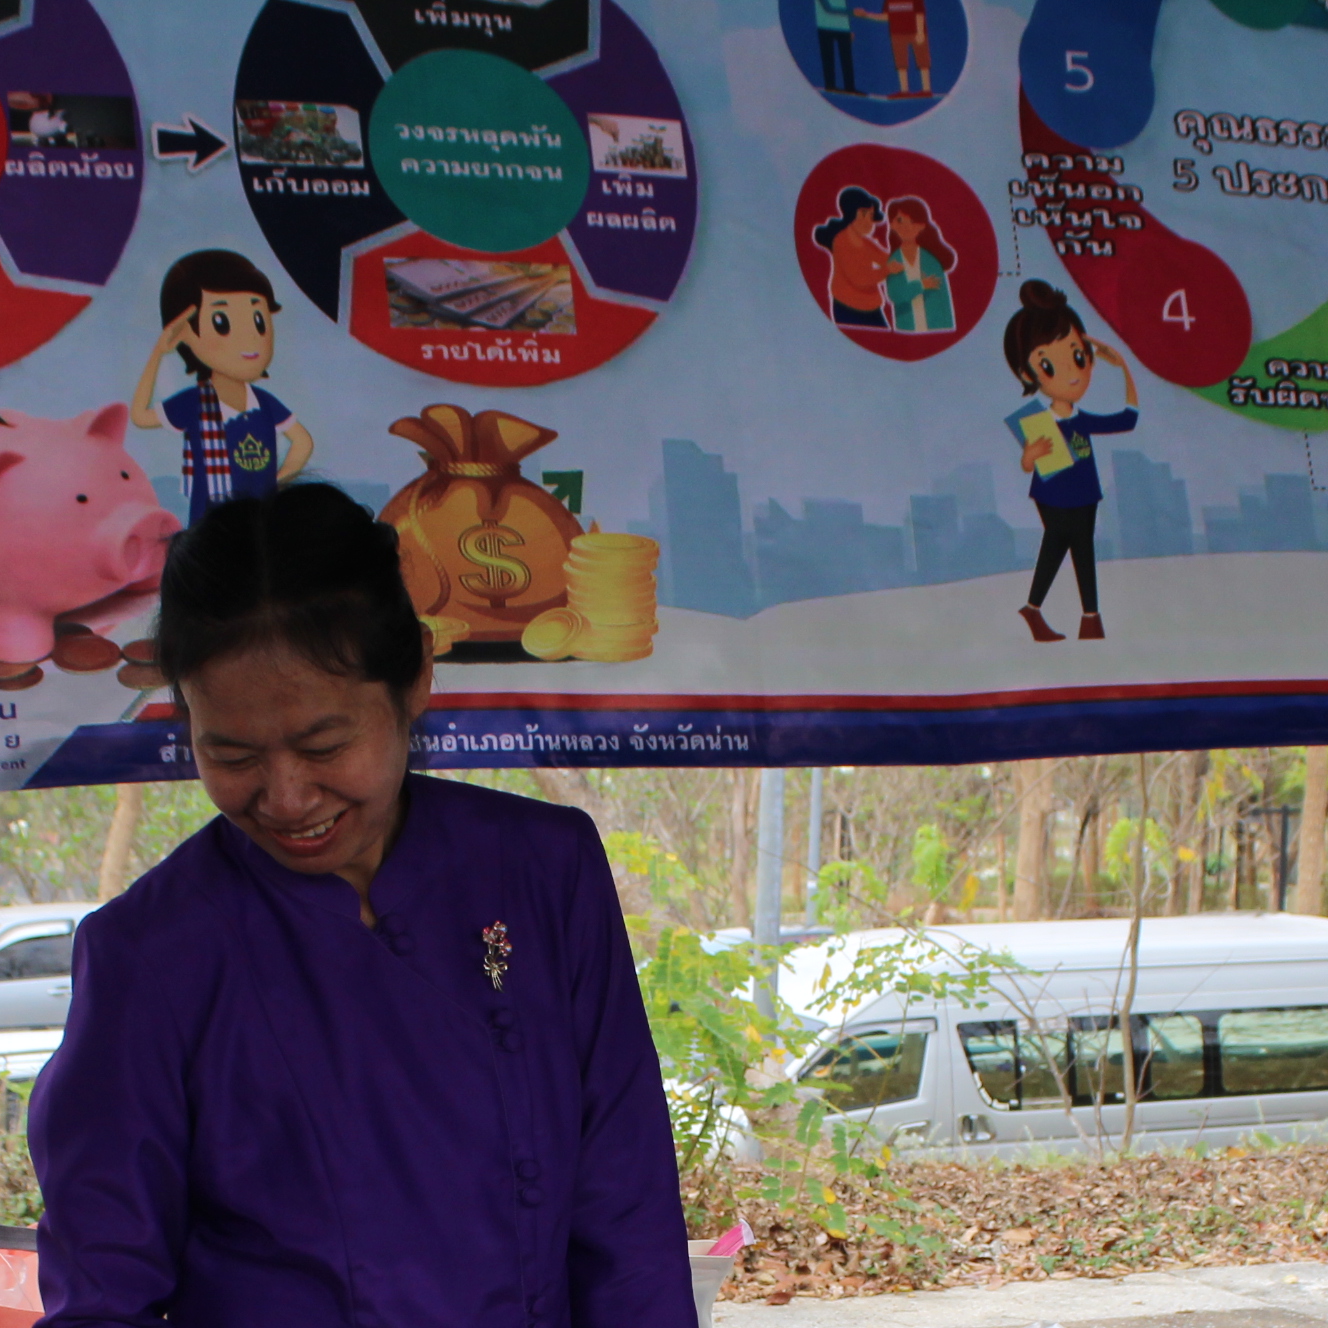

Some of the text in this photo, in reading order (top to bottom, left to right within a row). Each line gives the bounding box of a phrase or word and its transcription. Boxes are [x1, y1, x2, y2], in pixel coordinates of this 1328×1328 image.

[1064, 50, 1095, 93] 5
[394, 123, 561, 153] วงจรหลุดพ้น
[4, 152, 135, 181] ผลิตน้อย
[401, 157, 563, 181] ความยากจน
[1023, 153, 1125, 174] ความ
[1173, 158, 1199, 192] 5
[253, 169, 371, 197] เก็บออม
[1009, 171, 1143, 202] เห็นอก
[586, 206, 676, 232] ผลผลิต
[1015, 200, 1144, 230] เห็นใจ
[1056, 230, 1115, 256] กัน
[1161, 288, 1197, 333] 4
[420, 333, 561, 364] รายได้เพิ่ม
[629, 722, 749, 751] จังหวัดน่าน
